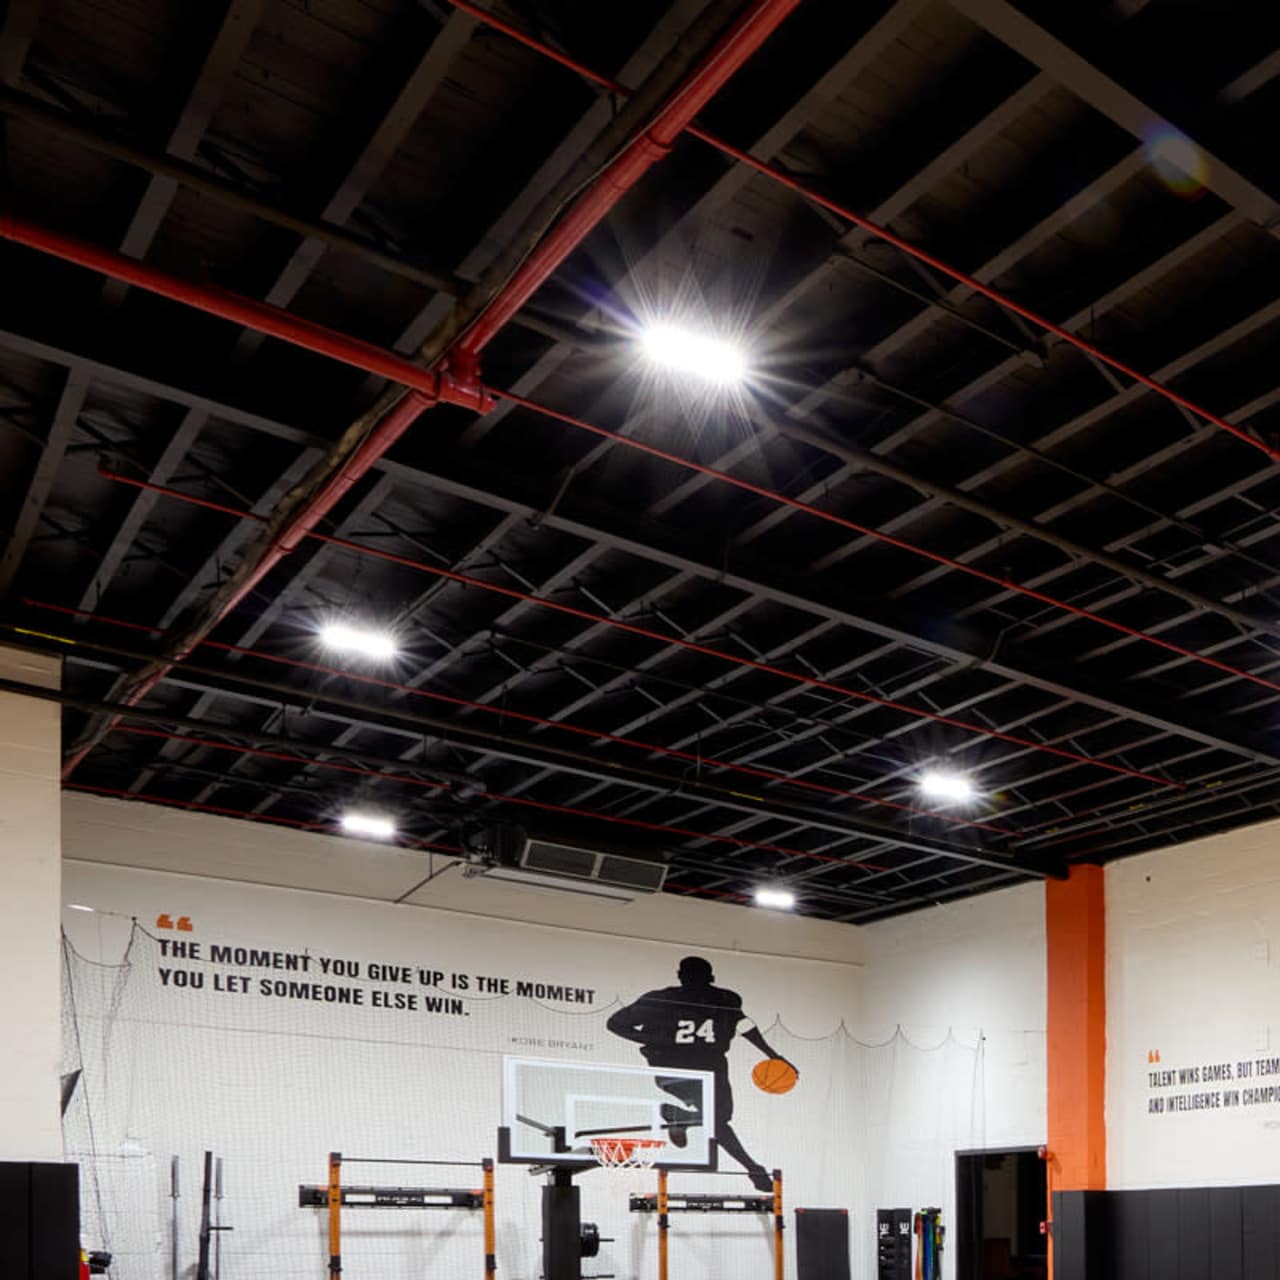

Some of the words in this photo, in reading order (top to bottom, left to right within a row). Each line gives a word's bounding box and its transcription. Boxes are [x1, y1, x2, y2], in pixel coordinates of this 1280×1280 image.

[158, 938, 202, 961] THE
[210, 944, 311, 973] MOMENT
[319, 957, 360, 978] YOU
[367, 963, 412, 984] GIVE
[418, 968, 445, 988] UP
[451, 973, 470, 991] IS
[475, 976, 510, 995] THE
[515, 981, 596, 1005] MOMENT
[158, 967, 204, 989] YOU
[213, 973, 251, 994] LET
[259, 978, 364, 1006] SOMEONE
[371, 990, 418, 1011] ELSE
[425, 996, 470, 1017] WIN.
[675, 1019, 716, 1044] 24
[1148, 1070, 1177, 1089] TALENT
[1179, 1066, 1200, 1086] WINS
[1237, 1061, 1253, 1079] BUT
[1148, 1096, 1164, 1114] AND
[1166, 1091, 1221, 1113] INTELLIGENCE
[1223, 1089, 1239, 1107] WIN
